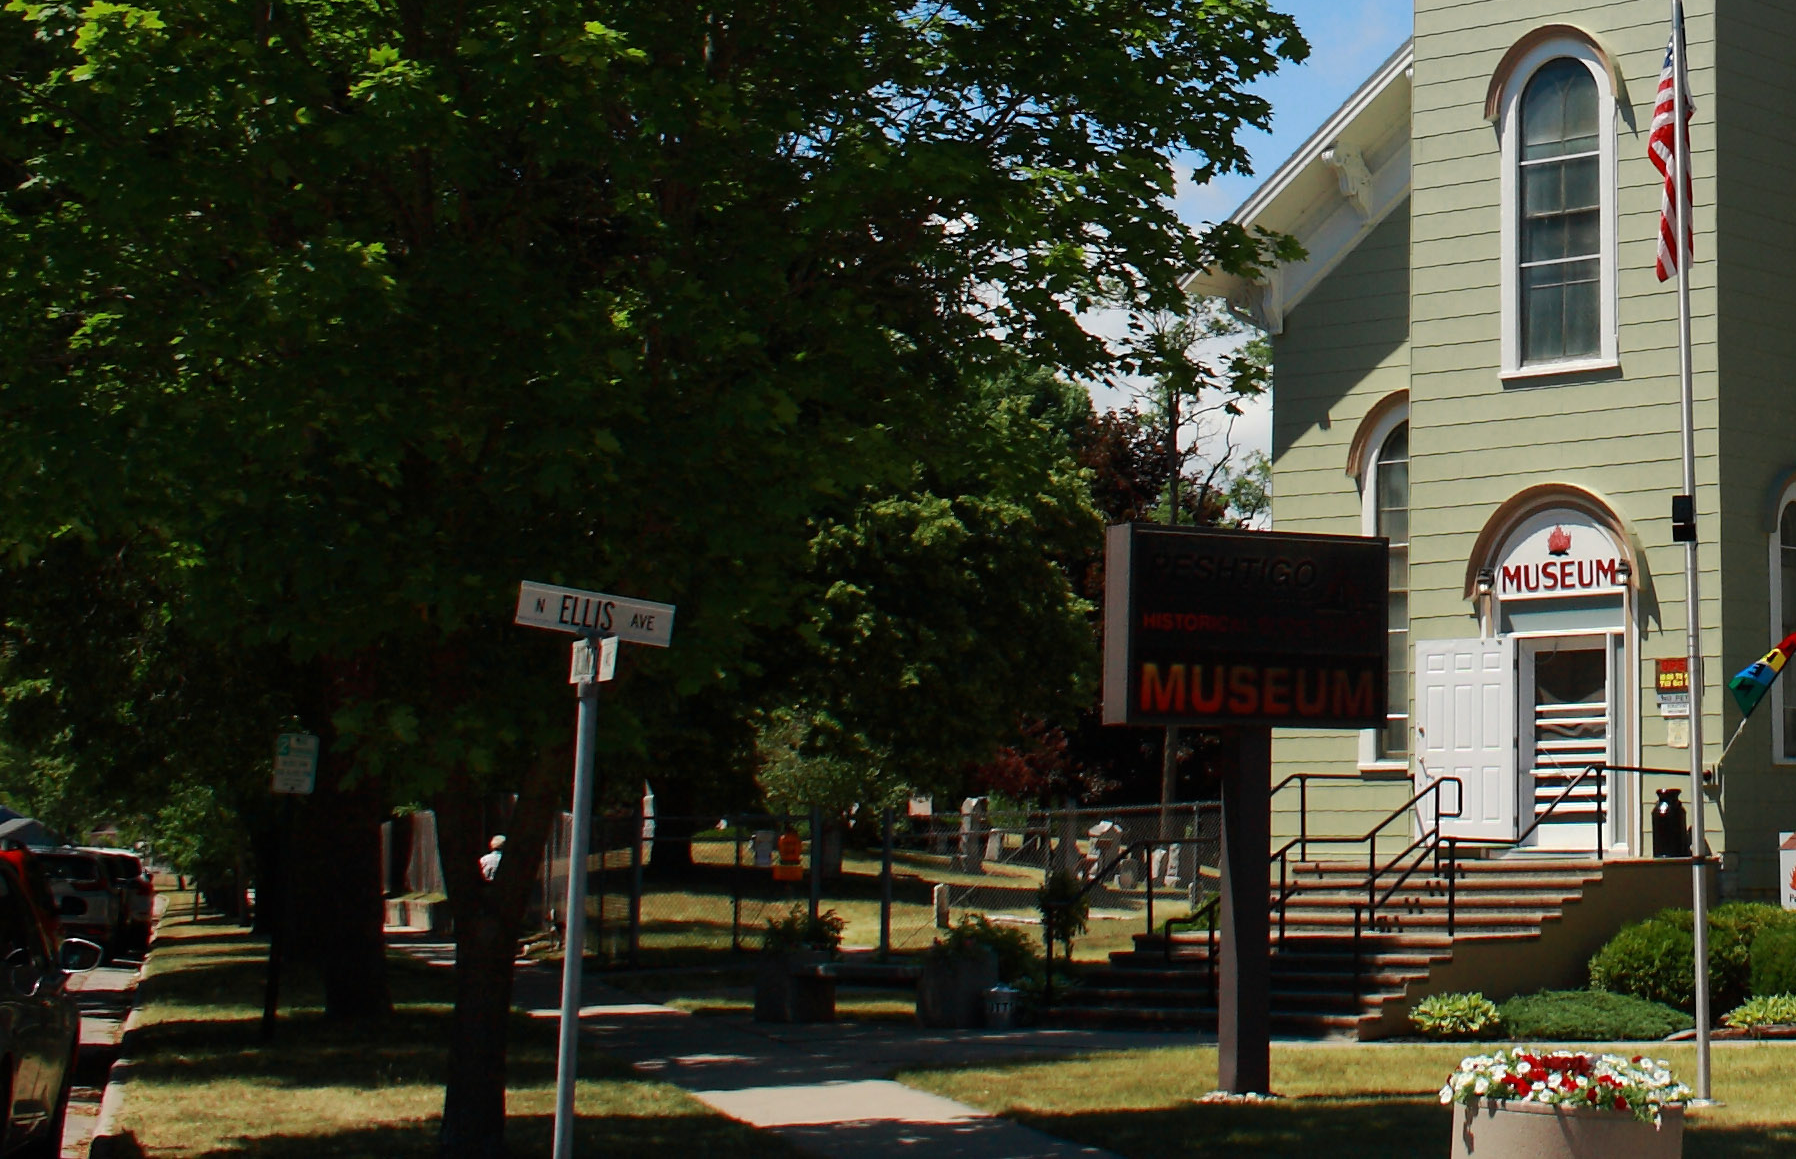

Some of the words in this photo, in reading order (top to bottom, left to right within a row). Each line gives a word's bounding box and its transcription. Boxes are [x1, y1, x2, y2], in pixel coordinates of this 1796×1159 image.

[1151, 551, 1317, 588] PESHTIGO
[1502, 557, 1618, 594] MUSEUM
[536, 597, 546, 613] N
[558, 594, 617, 631] ELLIS
[630, 612, 656, 631] AVE
[1661, 659, 1687, 672] OPE
[1139, 661, 1376, 718] MUSEUM
